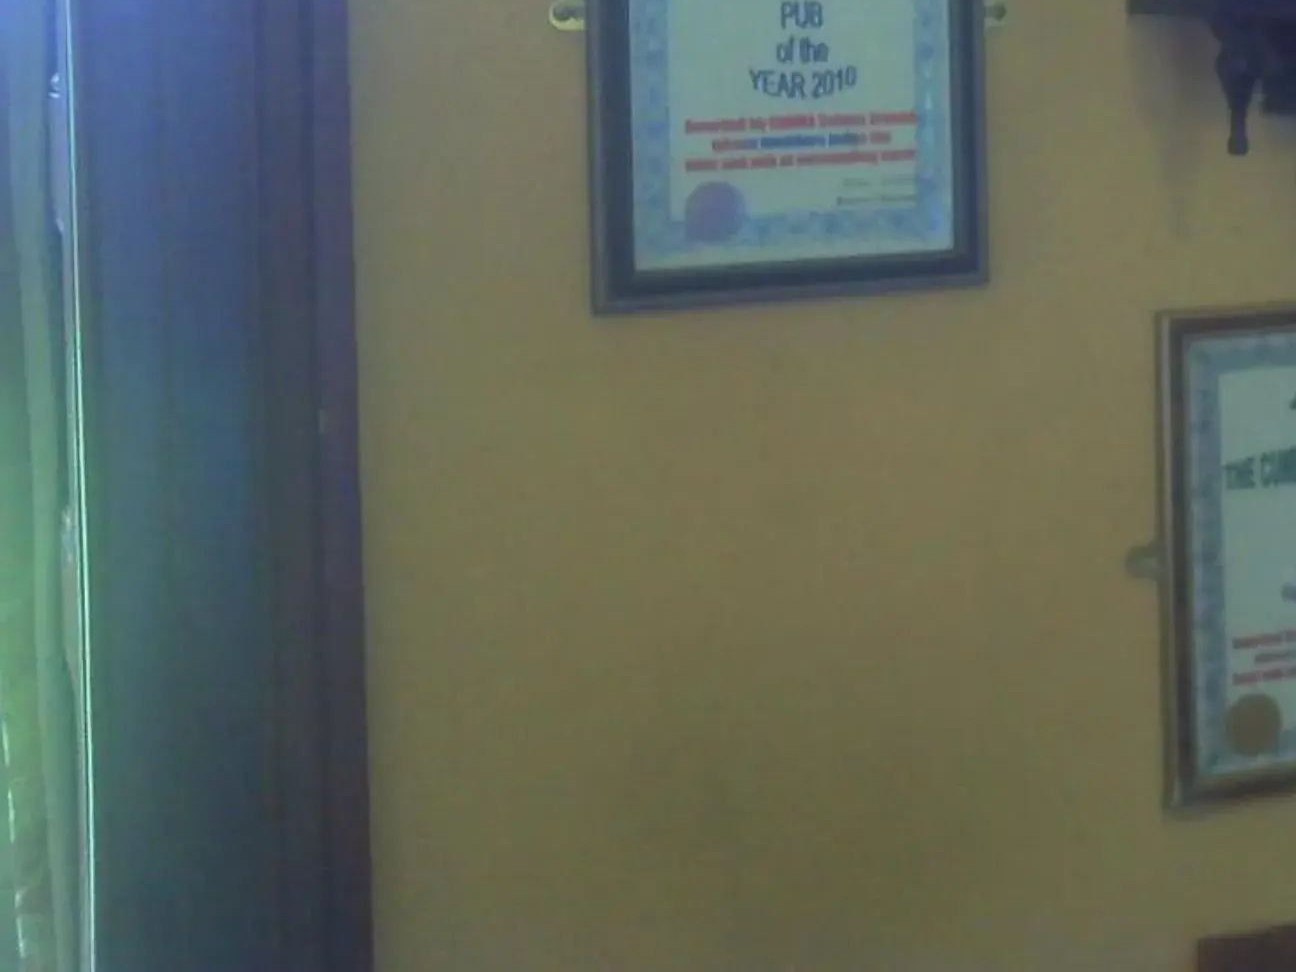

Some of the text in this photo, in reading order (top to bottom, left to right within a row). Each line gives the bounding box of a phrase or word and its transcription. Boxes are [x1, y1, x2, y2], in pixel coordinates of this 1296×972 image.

[780, 0, 823, 30] PUB
[776, 34, 829, 64] of the
[749, 65, 857, 99] YEAR 2010
